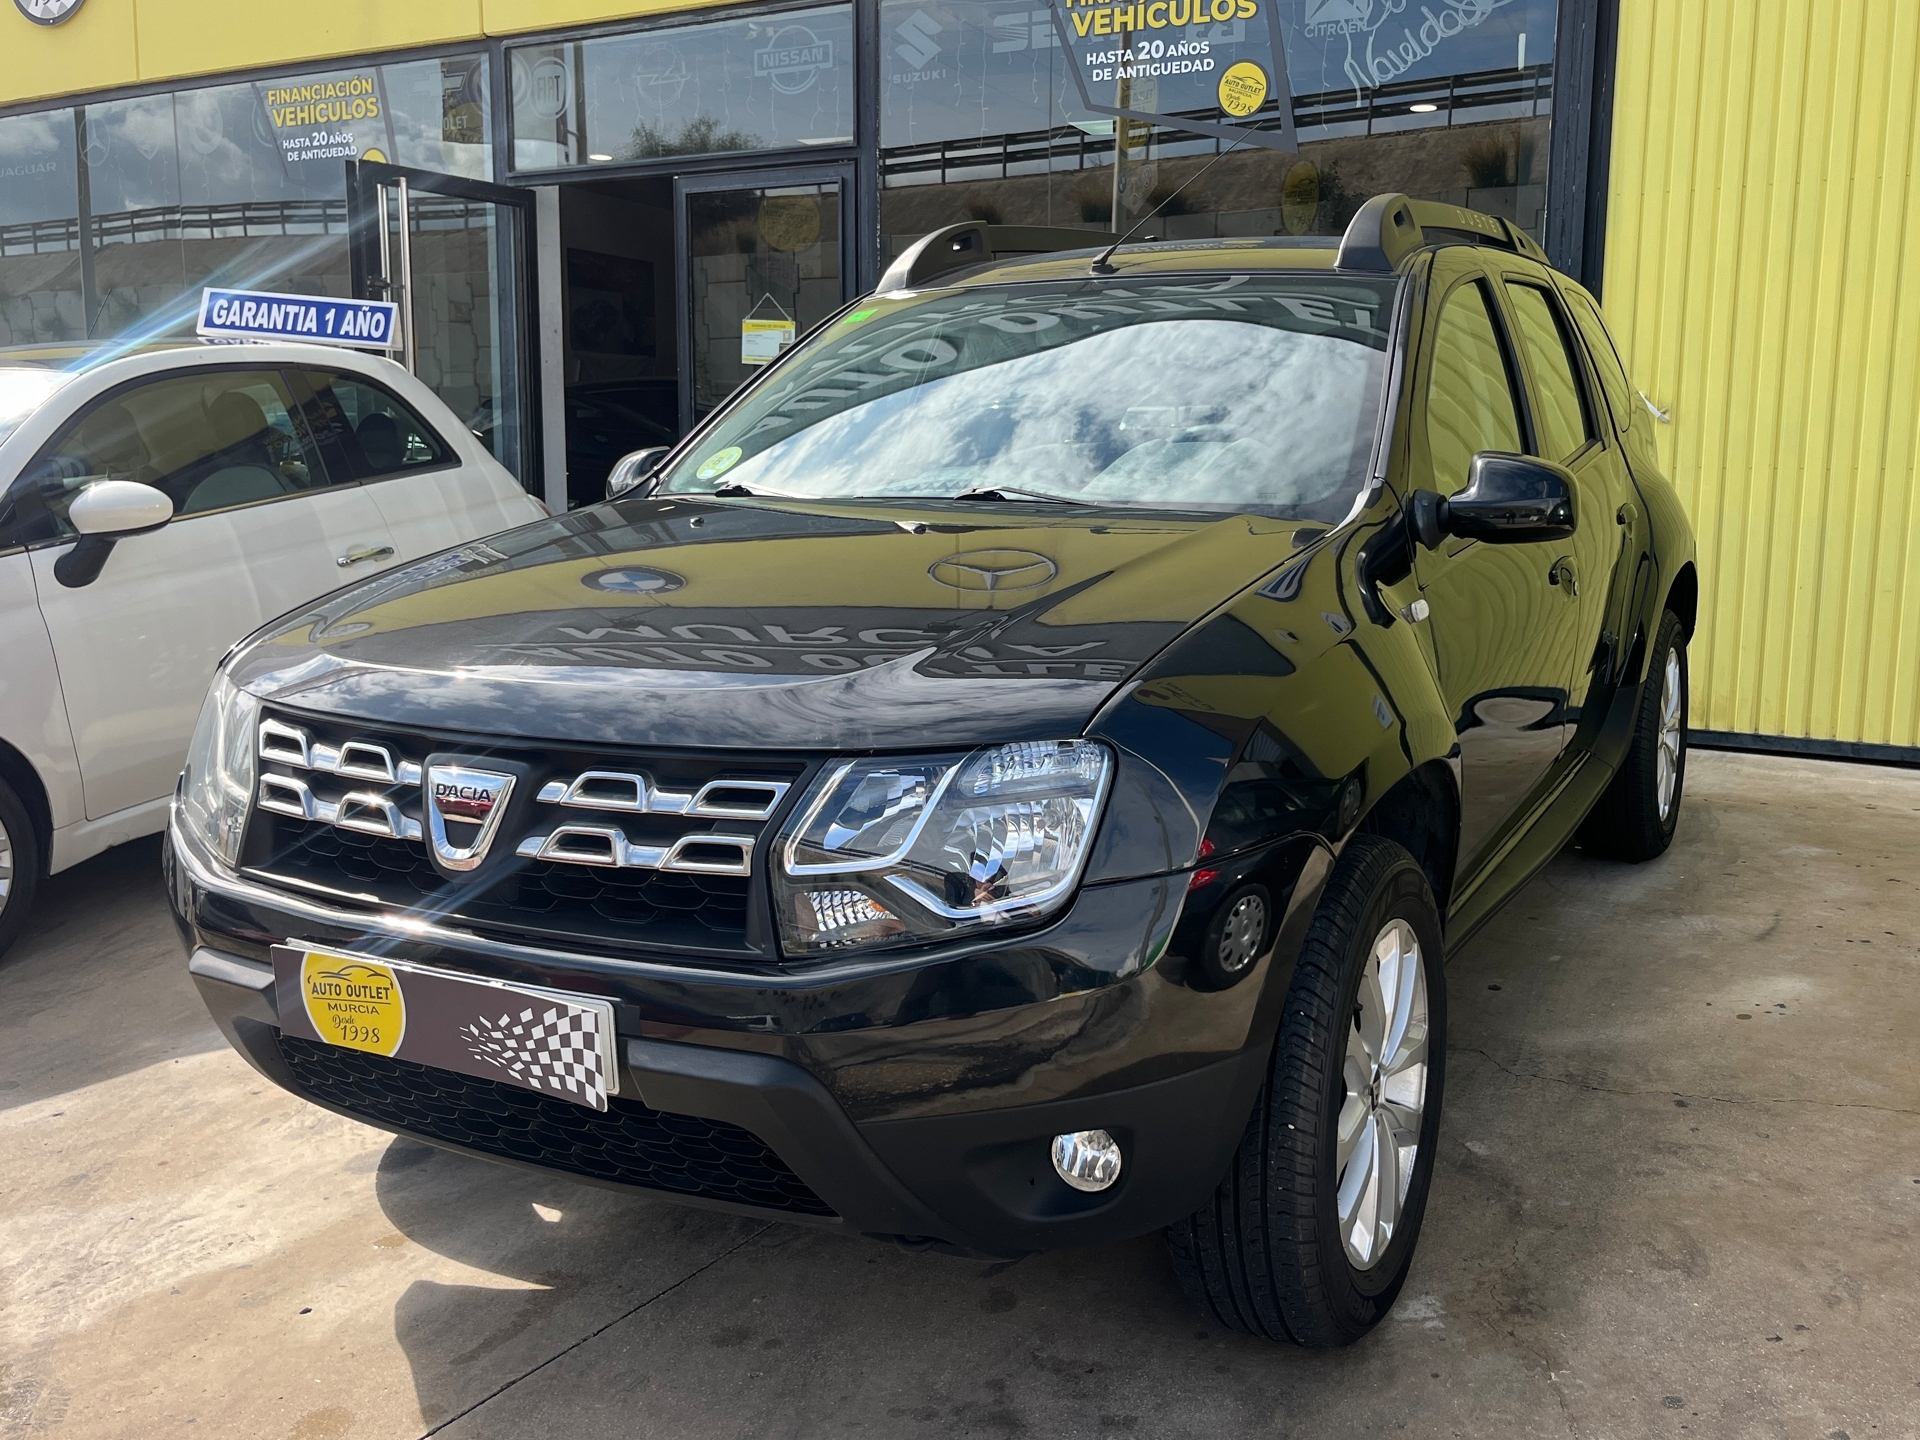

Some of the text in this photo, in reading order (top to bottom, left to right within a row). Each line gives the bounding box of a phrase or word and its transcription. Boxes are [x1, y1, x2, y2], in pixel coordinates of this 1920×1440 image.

[1071, 0, 1257, 37] VEHÍCULOS
[762, 47, 824, 68] NISSAN
[1086, 39, 1210, 66] HASTA 20 AÑOS
[892, 69, 947, 84] SUZUKI
[1092, 58, 1215, 82] DE ANTIGUEDAD
[267, 75, 374, 106] FINANCIACIÓN
[536, 74, 561, 103] FIAT
[1224, 78, 1262, 94] AUTO OUTLET
[271, 97, 379, 128] VEHÍCULOS
[1227, 99, 1254, 115] 1998
[282, 131, 354, 149] HASTA 20 AÑOS
[287, 145, 358, 162] DE ANTIGUEDAD
[0, 162, 57, 178] JAGUAR
[212, 298, 386, 339] GARANTIA 1 AÑO
[435, 783, 492, 802] DACIA
[311, 982, 390, 1000] AUTO OUTLET
[327, 1002, 380, 1015] MURCIA
[340, 1025, 381, 1044] 1998
